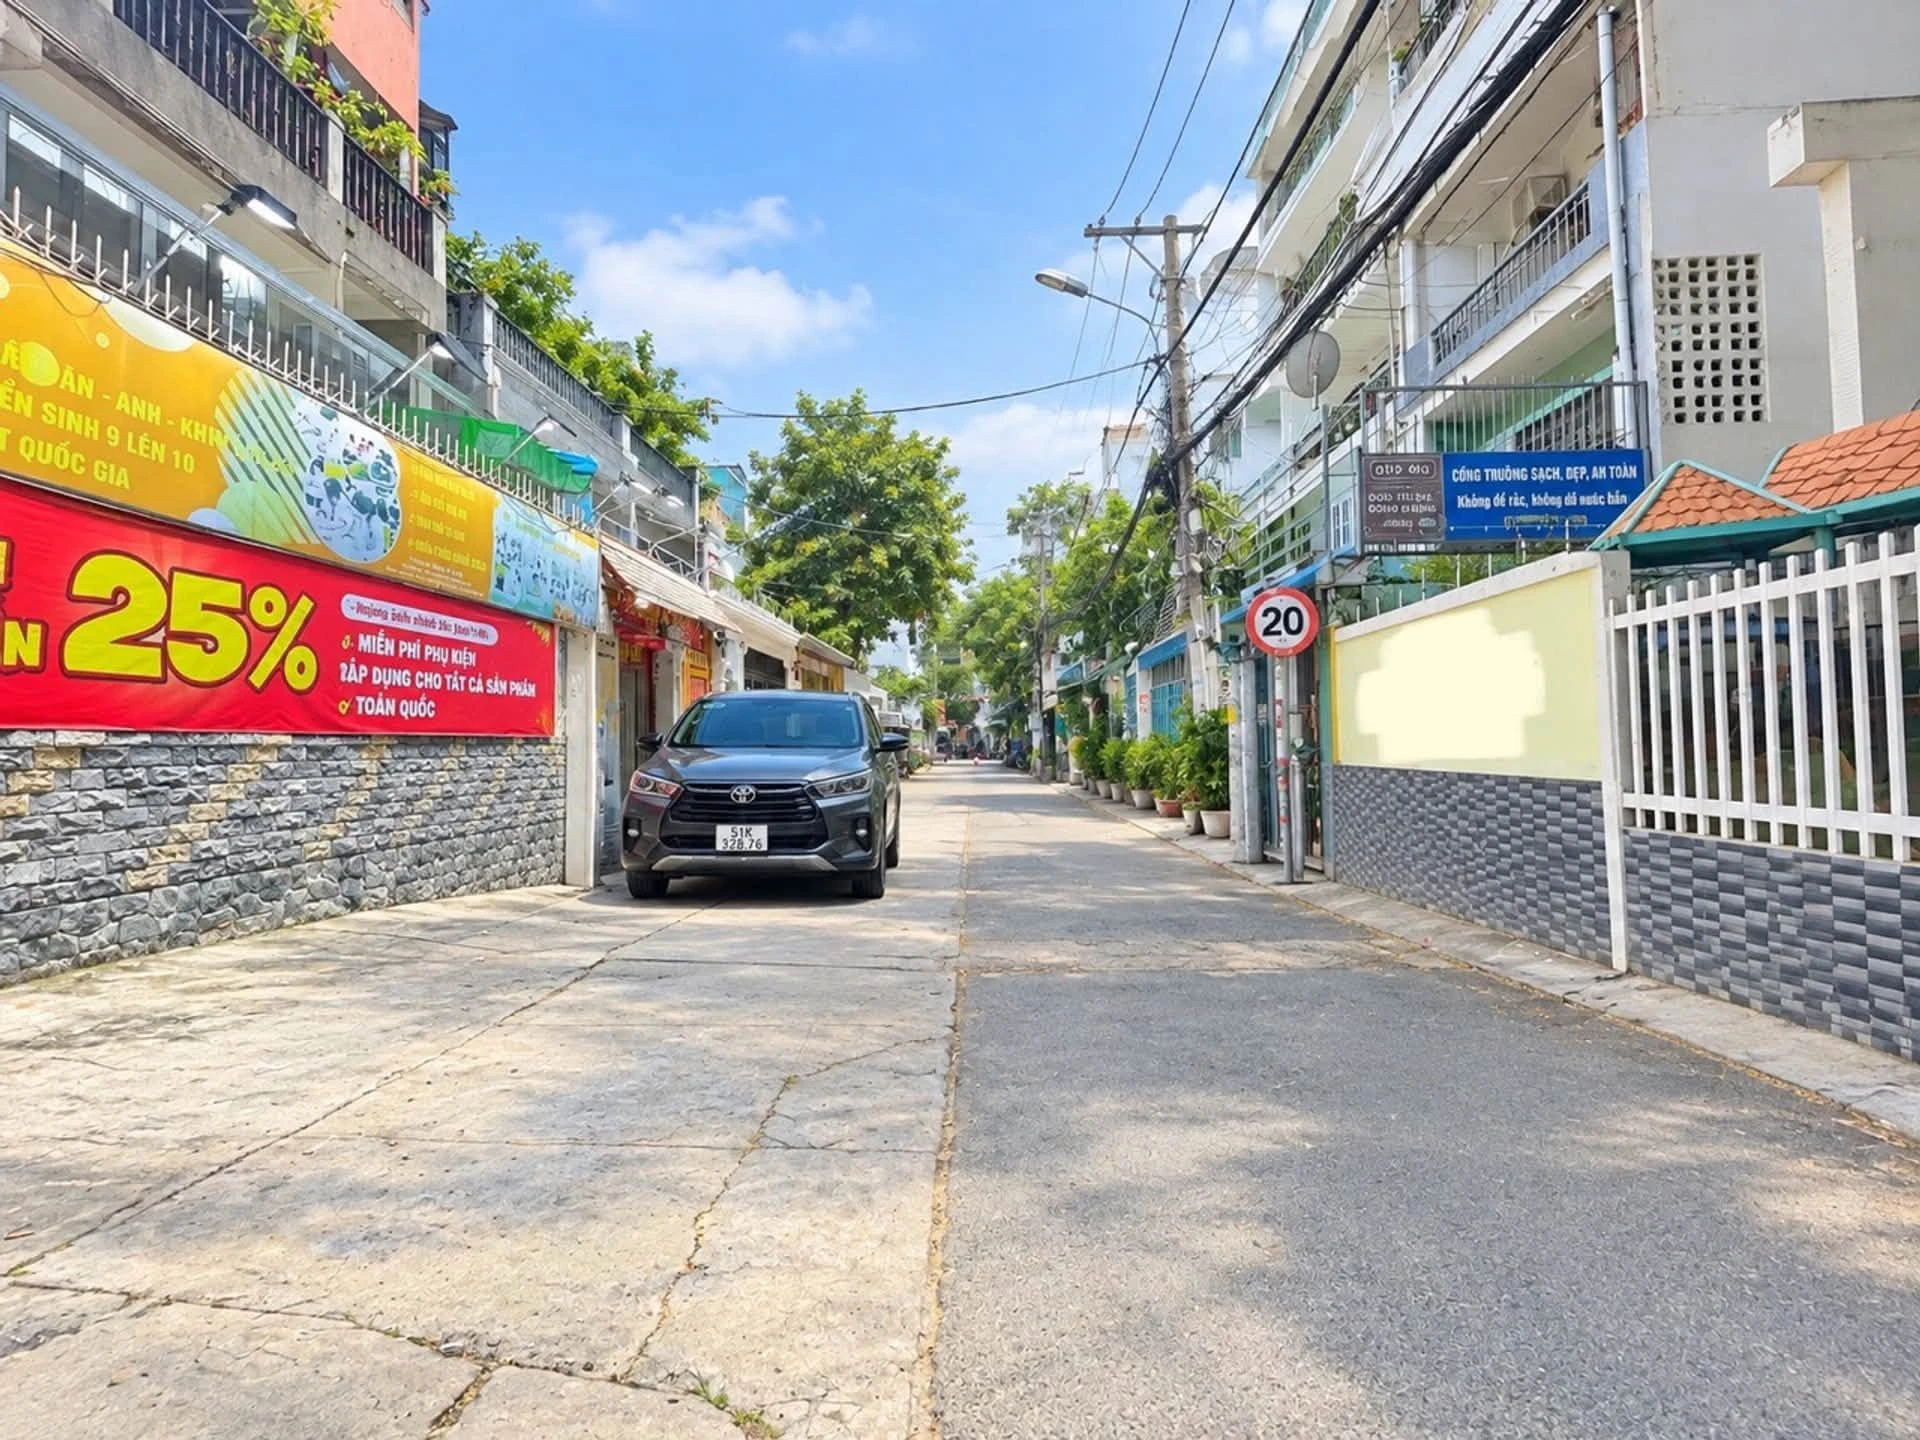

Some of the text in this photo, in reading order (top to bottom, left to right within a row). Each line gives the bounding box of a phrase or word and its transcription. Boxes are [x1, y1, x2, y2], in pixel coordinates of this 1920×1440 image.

[115, 391, 161, 425] ANH
[41, 401, 99, 441] SINH
[106, 425, 120, 448] 9
[173, 449, 195, 474] 10
[19, 434, 86, 475] QUỐC
[93, 460, 130, 489] GIA
[62, 551, 318, 692] 25%
[1262, 606, 1304, 636] 20
[399, 639, 421, 659] PHÍ
[372, 665, 411, 690] DỤNG
[415, 671, 442, 690] CHO
[731, 826, 753, 838] 51K
